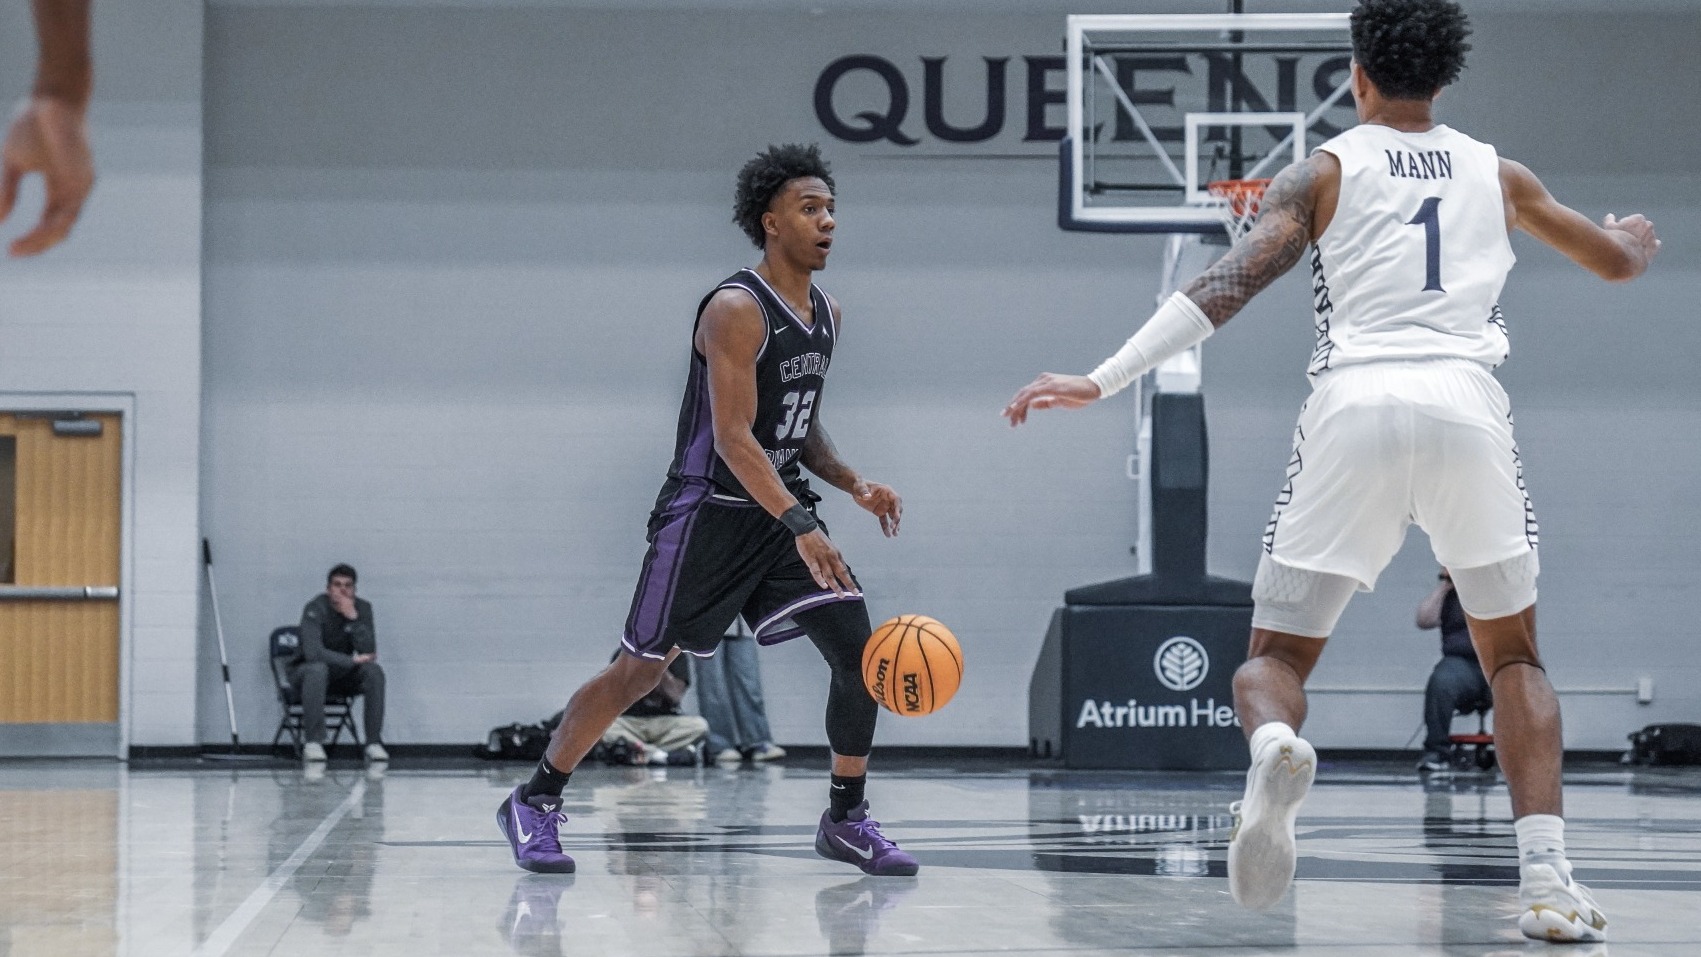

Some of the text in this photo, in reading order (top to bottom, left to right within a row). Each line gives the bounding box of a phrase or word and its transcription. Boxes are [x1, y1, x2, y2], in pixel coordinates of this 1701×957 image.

[1384, 149, 1453, 180] MANN
[1404, 196, 1447, 294] 1
[775, 390, 817, 441] 32
[903, 672, 921, 712] NCAA
[1077, 698, 1187, 729] Atrium
